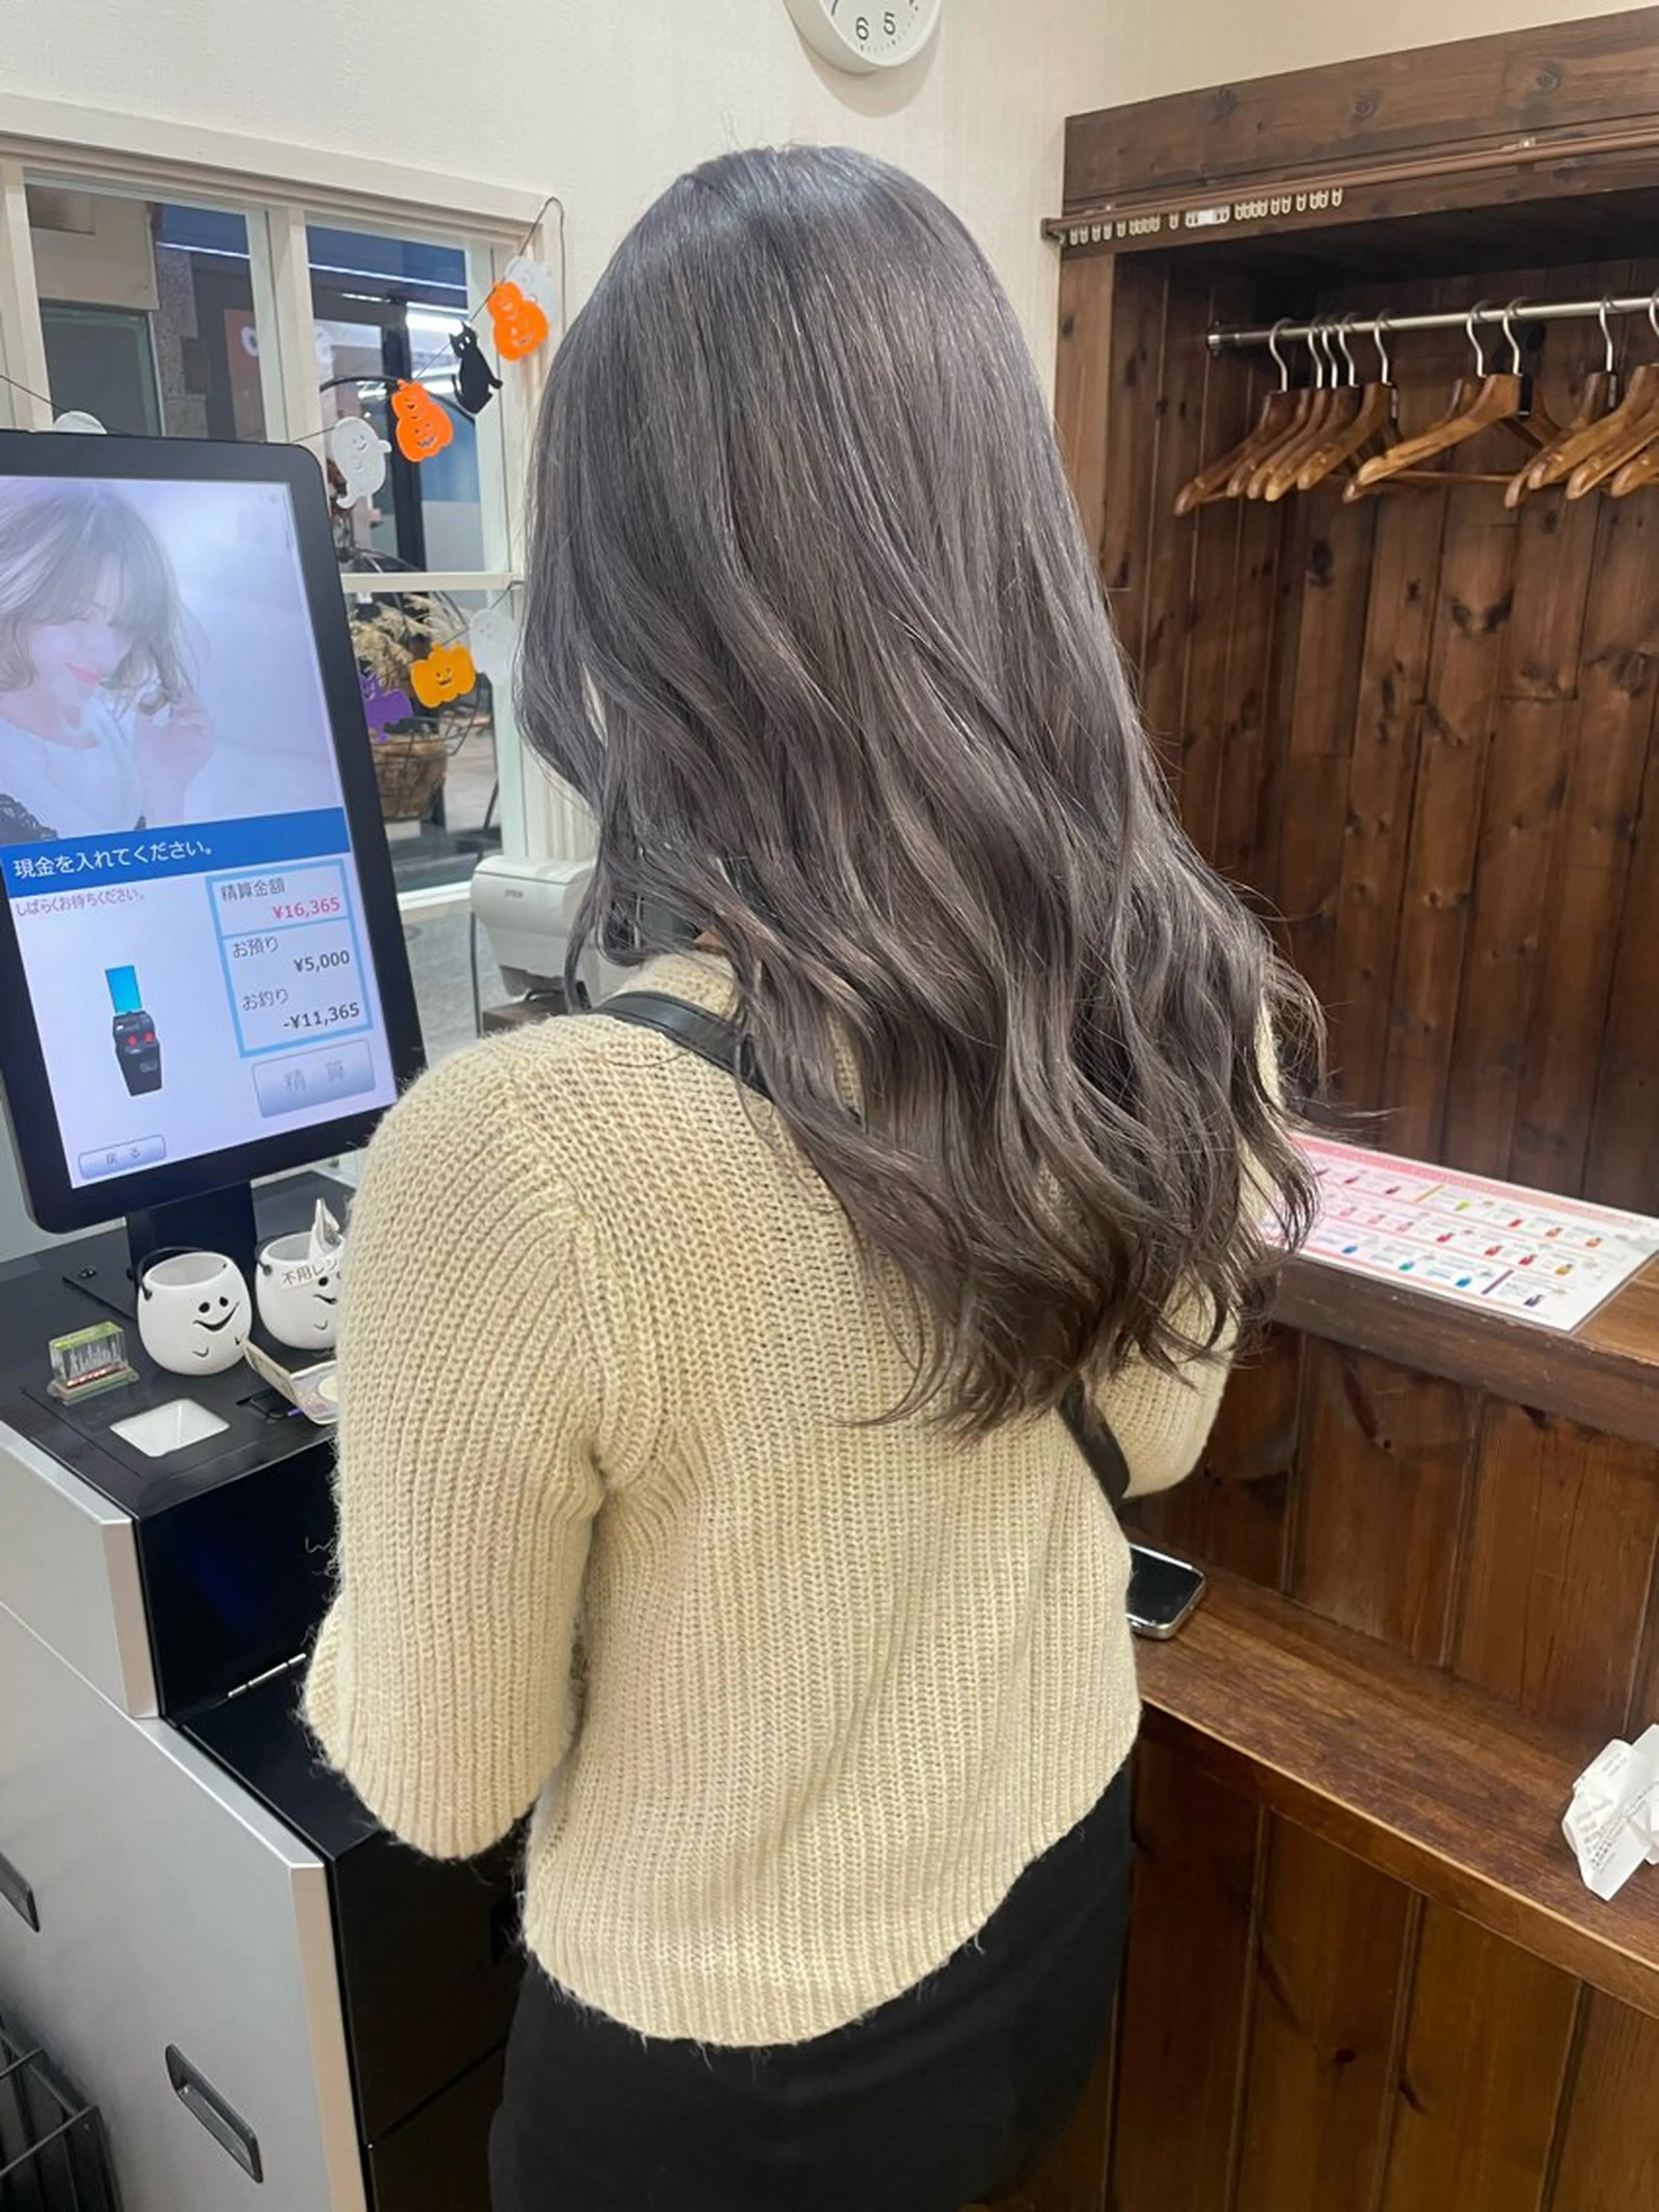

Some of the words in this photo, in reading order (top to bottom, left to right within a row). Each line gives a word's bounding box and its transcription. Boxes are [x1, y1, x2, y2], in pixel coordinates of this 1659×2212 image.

[856, 16, 869, 41] 6
[884, 11, 896, 35] 5
[13, 840, 212, 879] 現金を入れてください。
[272, 896, 340, 919] ¥16,365
[233, 936, 279, 958] お預り
[293, 950, 350, 973] ¥5,000
[242, 988, 289, 1011] お釣り
[283, 1002, 359, 1029] -¥11,365
